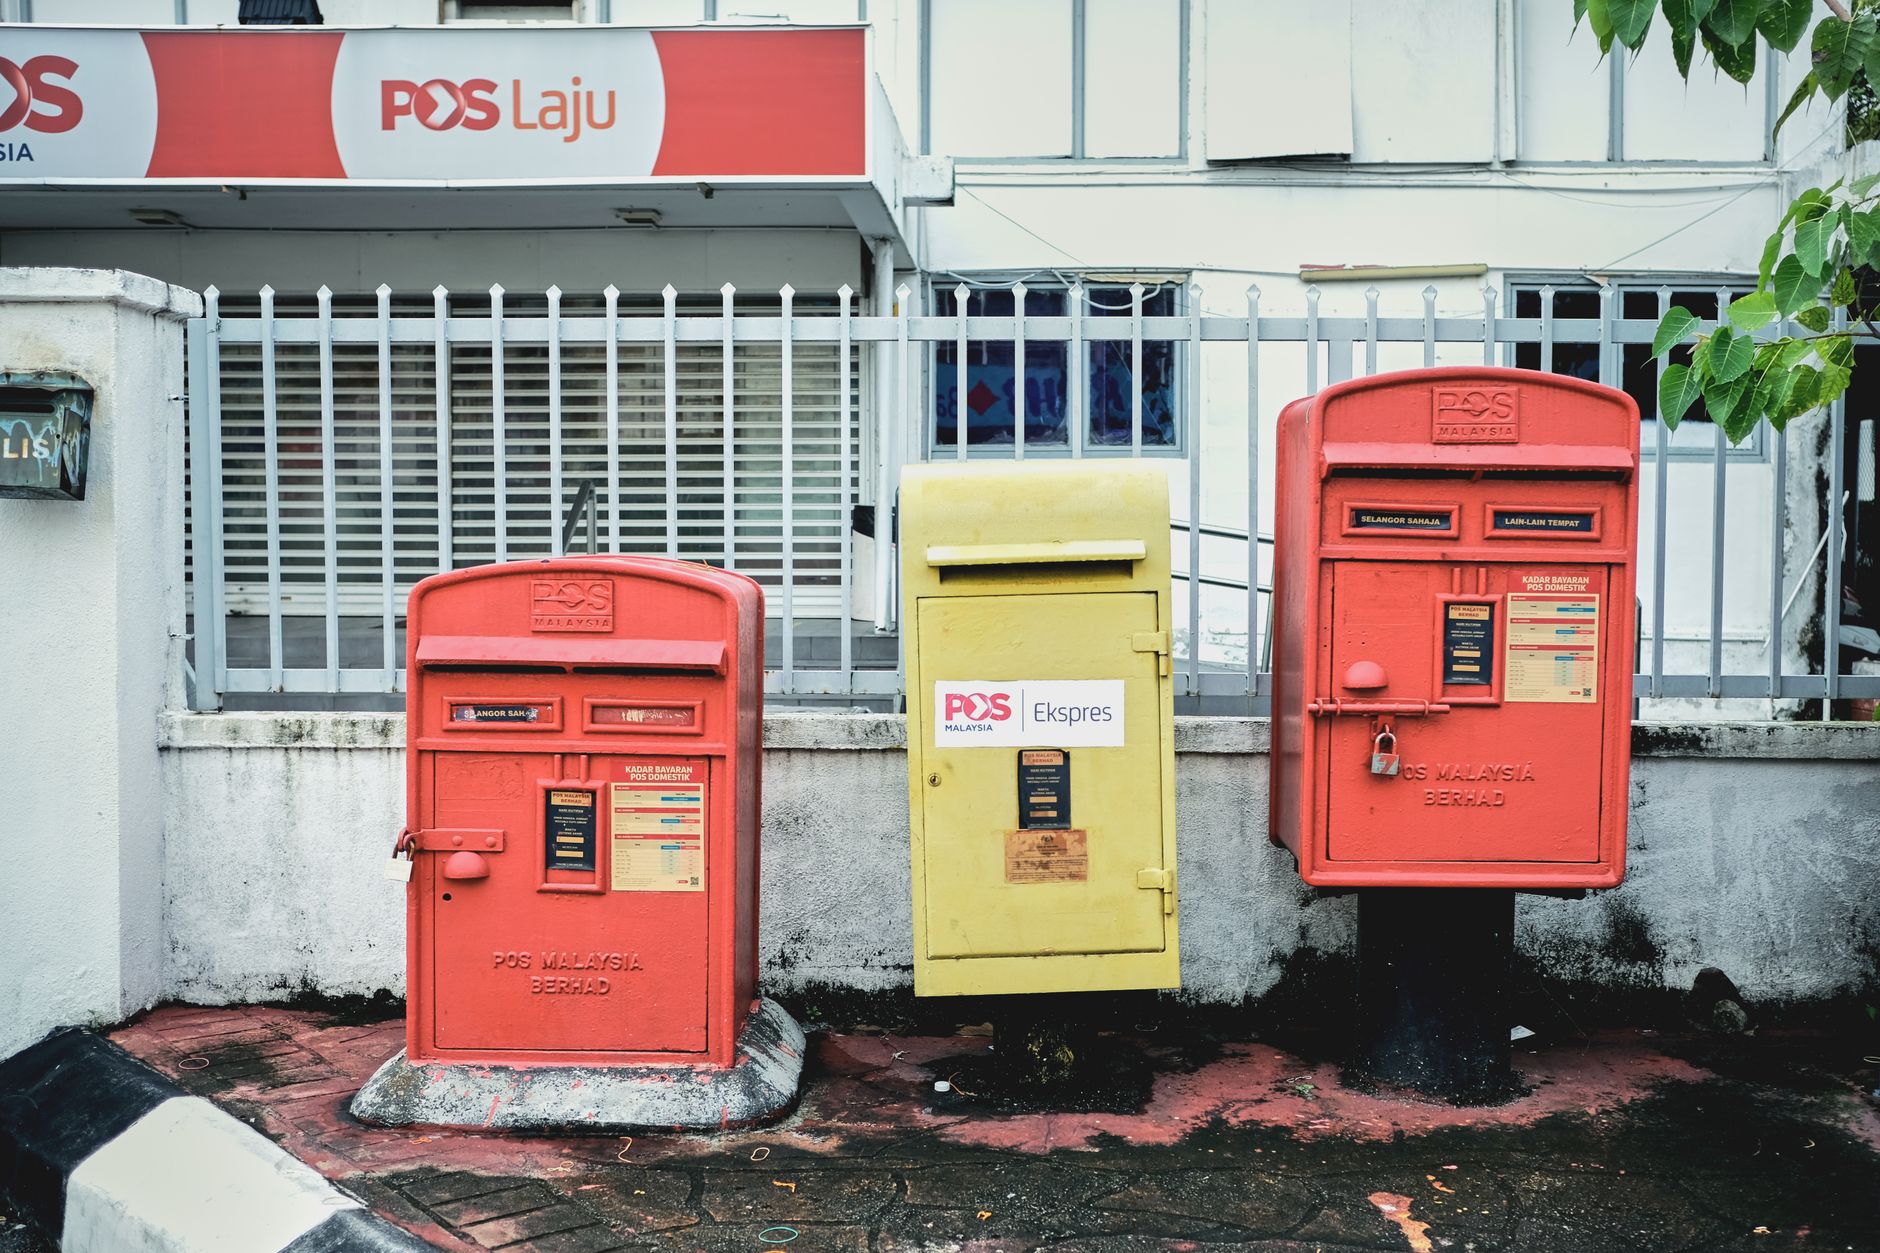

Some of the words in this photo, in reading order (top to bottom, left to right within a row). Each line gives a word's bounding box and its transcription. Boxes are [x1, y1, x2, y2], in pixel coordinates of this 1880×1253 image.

[381, 78, 500, 132] POS
[512, 76, 616, 143] Laju
[1438, 391, 1513, 422] POS
[1438, 427, 1513, 436] MALAYSIA
[1361, 515, 1405, 524] SELANGOR
[1407, 517, 1440, 525] SAHAJA
[1505, 518, 1546, 526] LAIN-LAIN
[1547, 519, 1580, 527] TEMPAT
[1522, 576, 1551, 584] KADAR
[1551, 576, 1589, 584] BAYARAN
[1527, 583, 1543, 591] POS
[1544, 583, 1586, 591] DOMESTIK
[533, 583, 610, 613] POS
[534, 618, 609, 628] MALAYSIA
[945, 692, 1011, 722] POS
[1034, 702, 1112, 727] Ekspres
[945, 724, 993, 732] MALAYSIA
[630, 773, 648, 781] POS
[648, 773, 690, 781] DOMESTIK
[655, 766, 693, 774] BAYARAN
[1399, 763, 1427, 780] OS
[1436, 762, 1535, 782] MALAYSIA
[1424, 788, 1505, 807] BERHAD
[493, 951, 531, 969] POS
[541, 950, 643, 971] MALAYSIA
[530, 976, 611, 995] BERHAD
